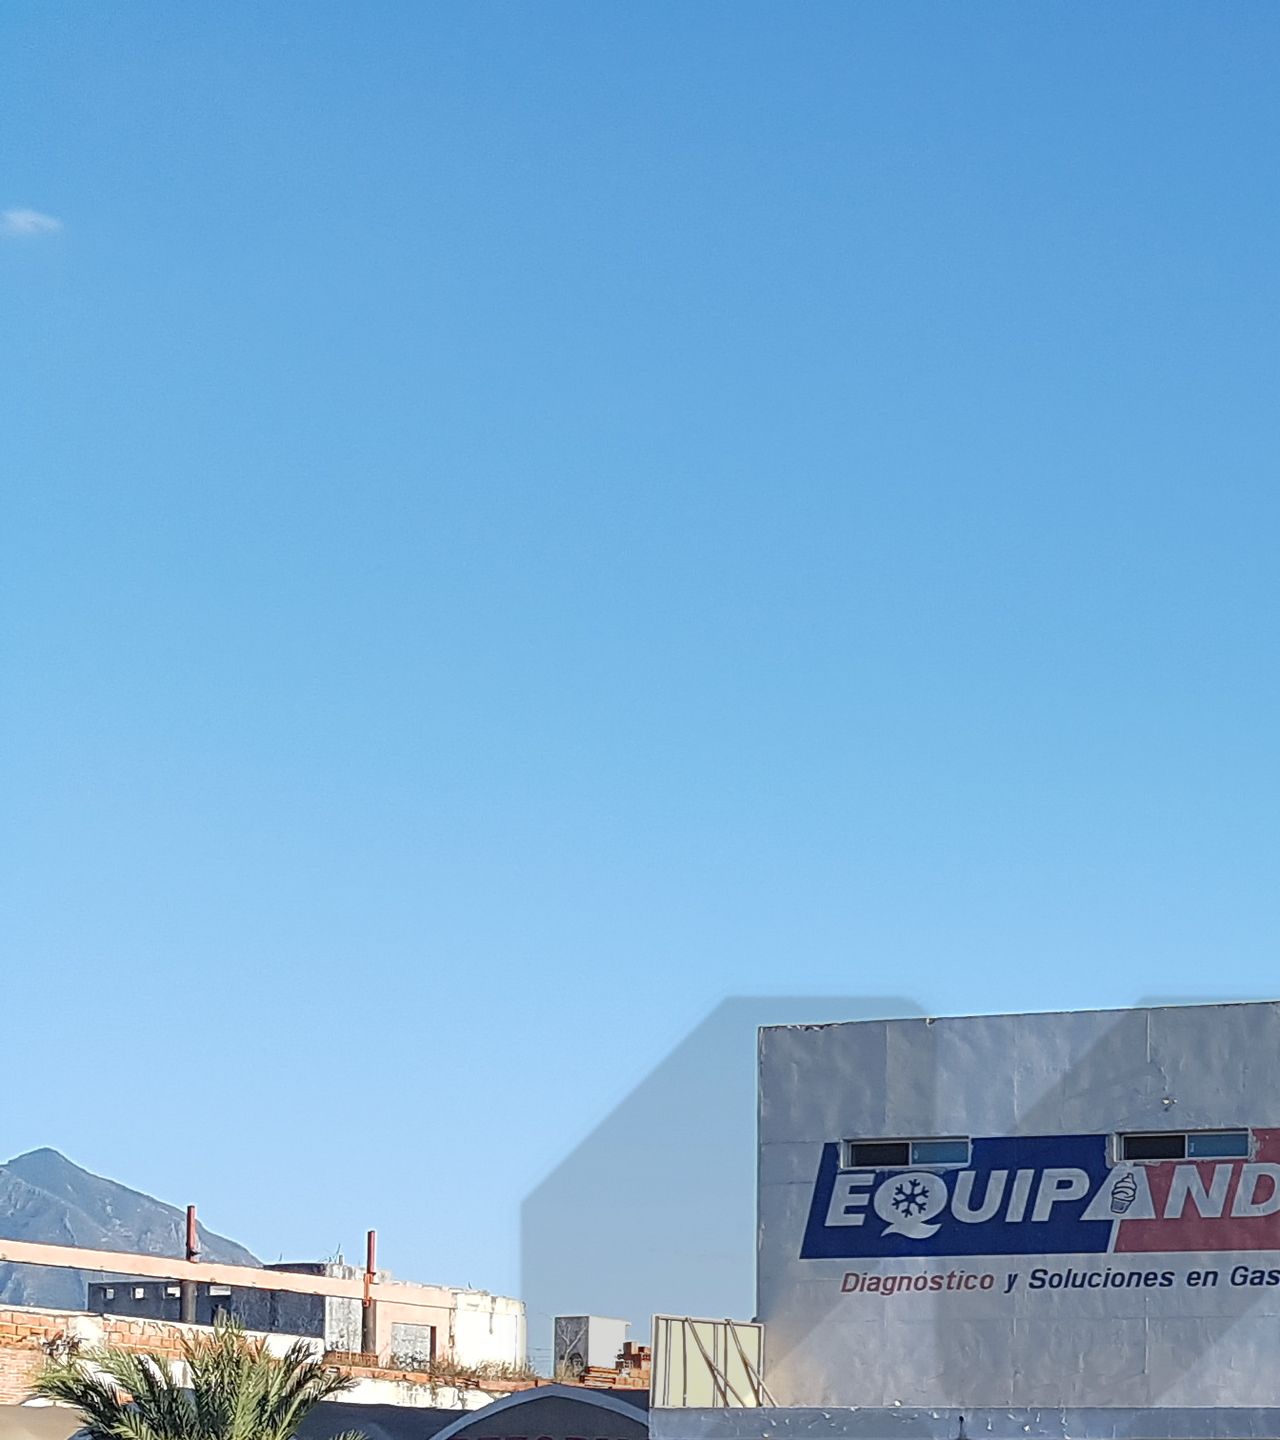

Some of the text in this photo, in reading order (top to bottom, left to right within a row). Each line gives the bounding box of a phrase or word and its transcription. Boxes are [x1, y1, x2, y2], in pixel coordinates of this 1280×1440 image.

[841, 1270, 995, 1296] Diagnóstico
[1003, 1272, 1018, 1294] y
[1028, 1267, 1175, 1289] Soluciones
[1186, 1270, 1219, 1288] en
